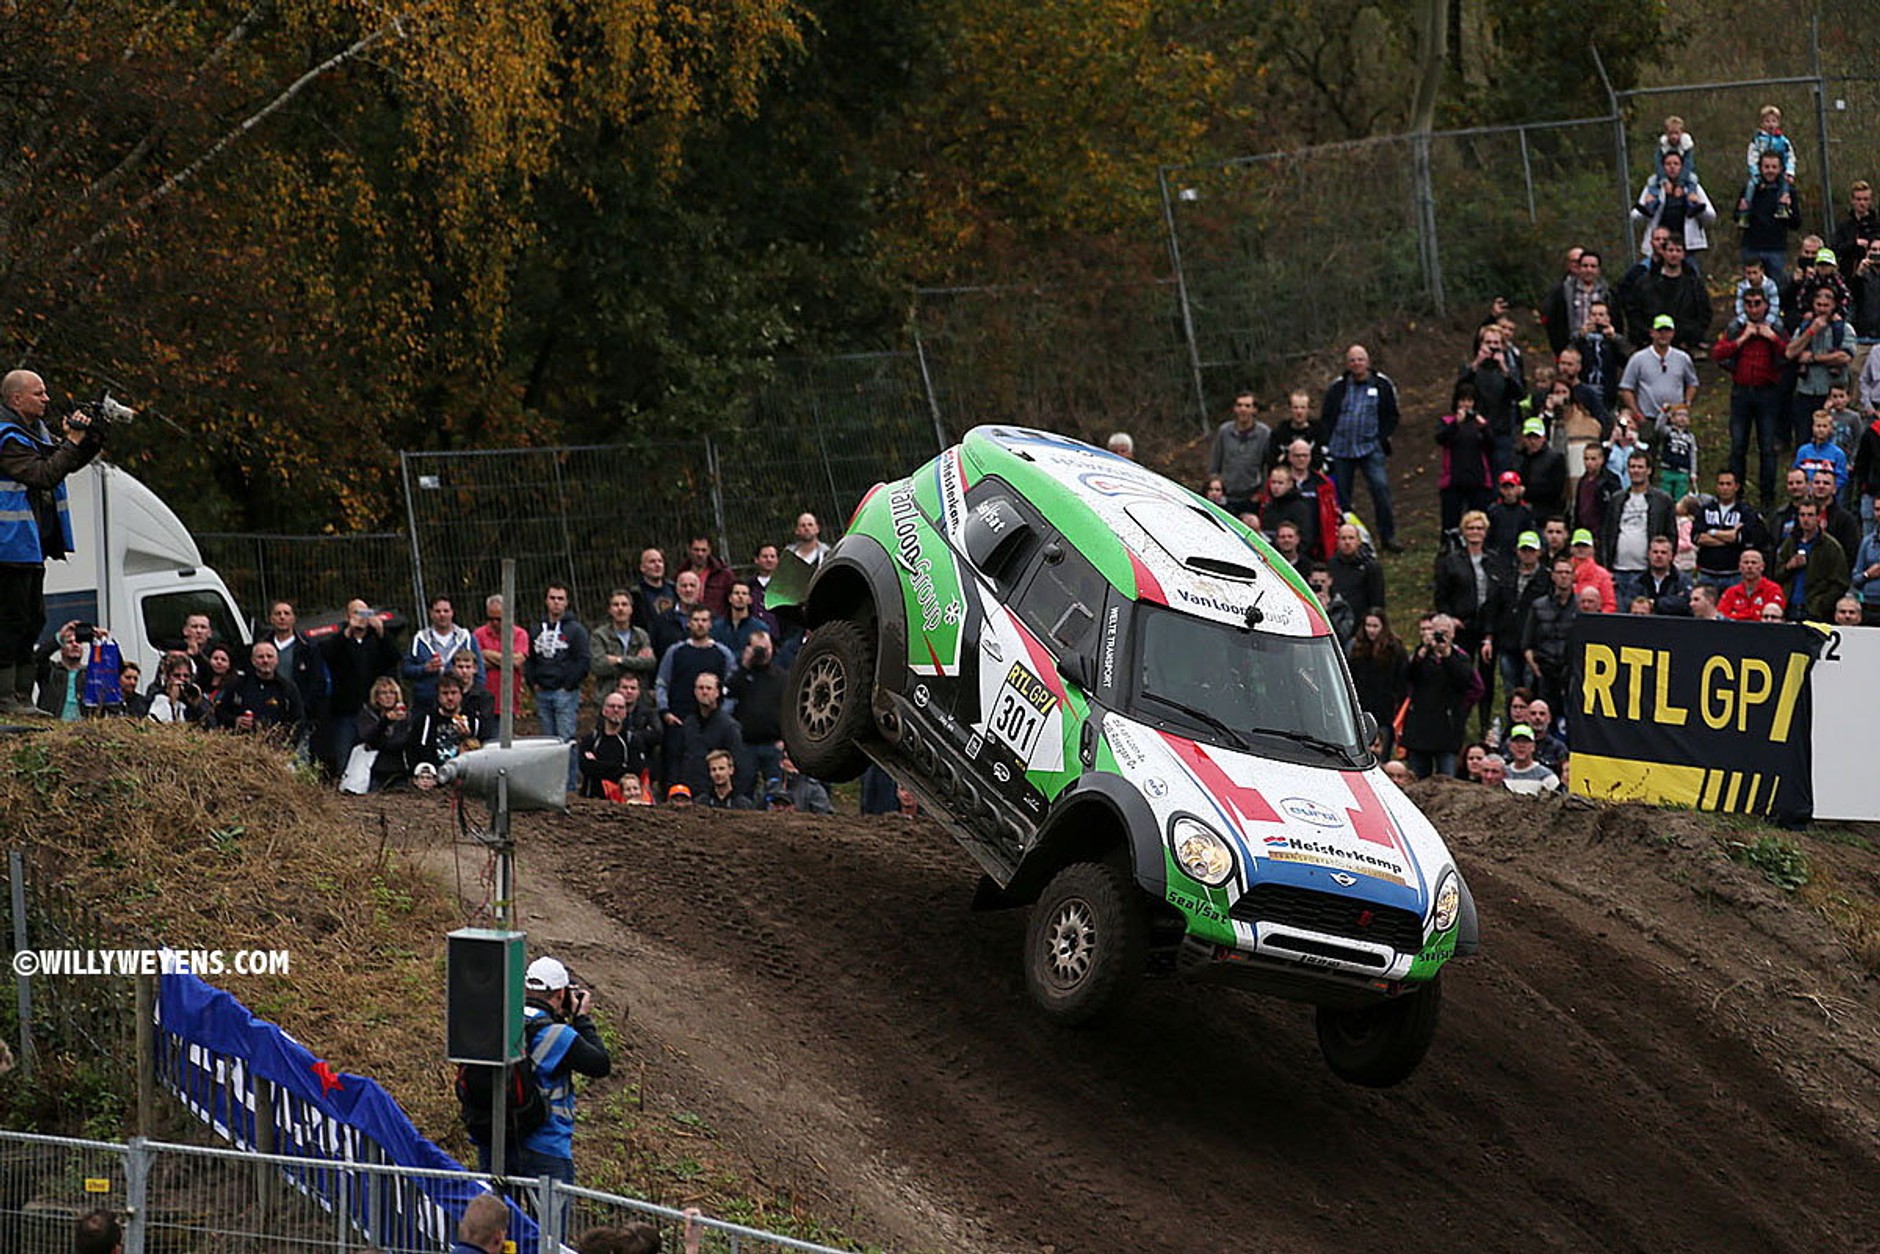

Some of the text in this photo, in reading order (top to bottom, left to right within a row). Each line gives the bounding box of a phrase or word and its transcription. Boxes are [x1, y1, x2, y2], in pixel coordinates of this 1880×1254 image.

[1007, 664, 1031, 697] RTL
[1582, 643, 1689, 726] RTL
[996, 694, 1037, 752] 301
[1289, 838, 1402, 874] Heisterkamp
